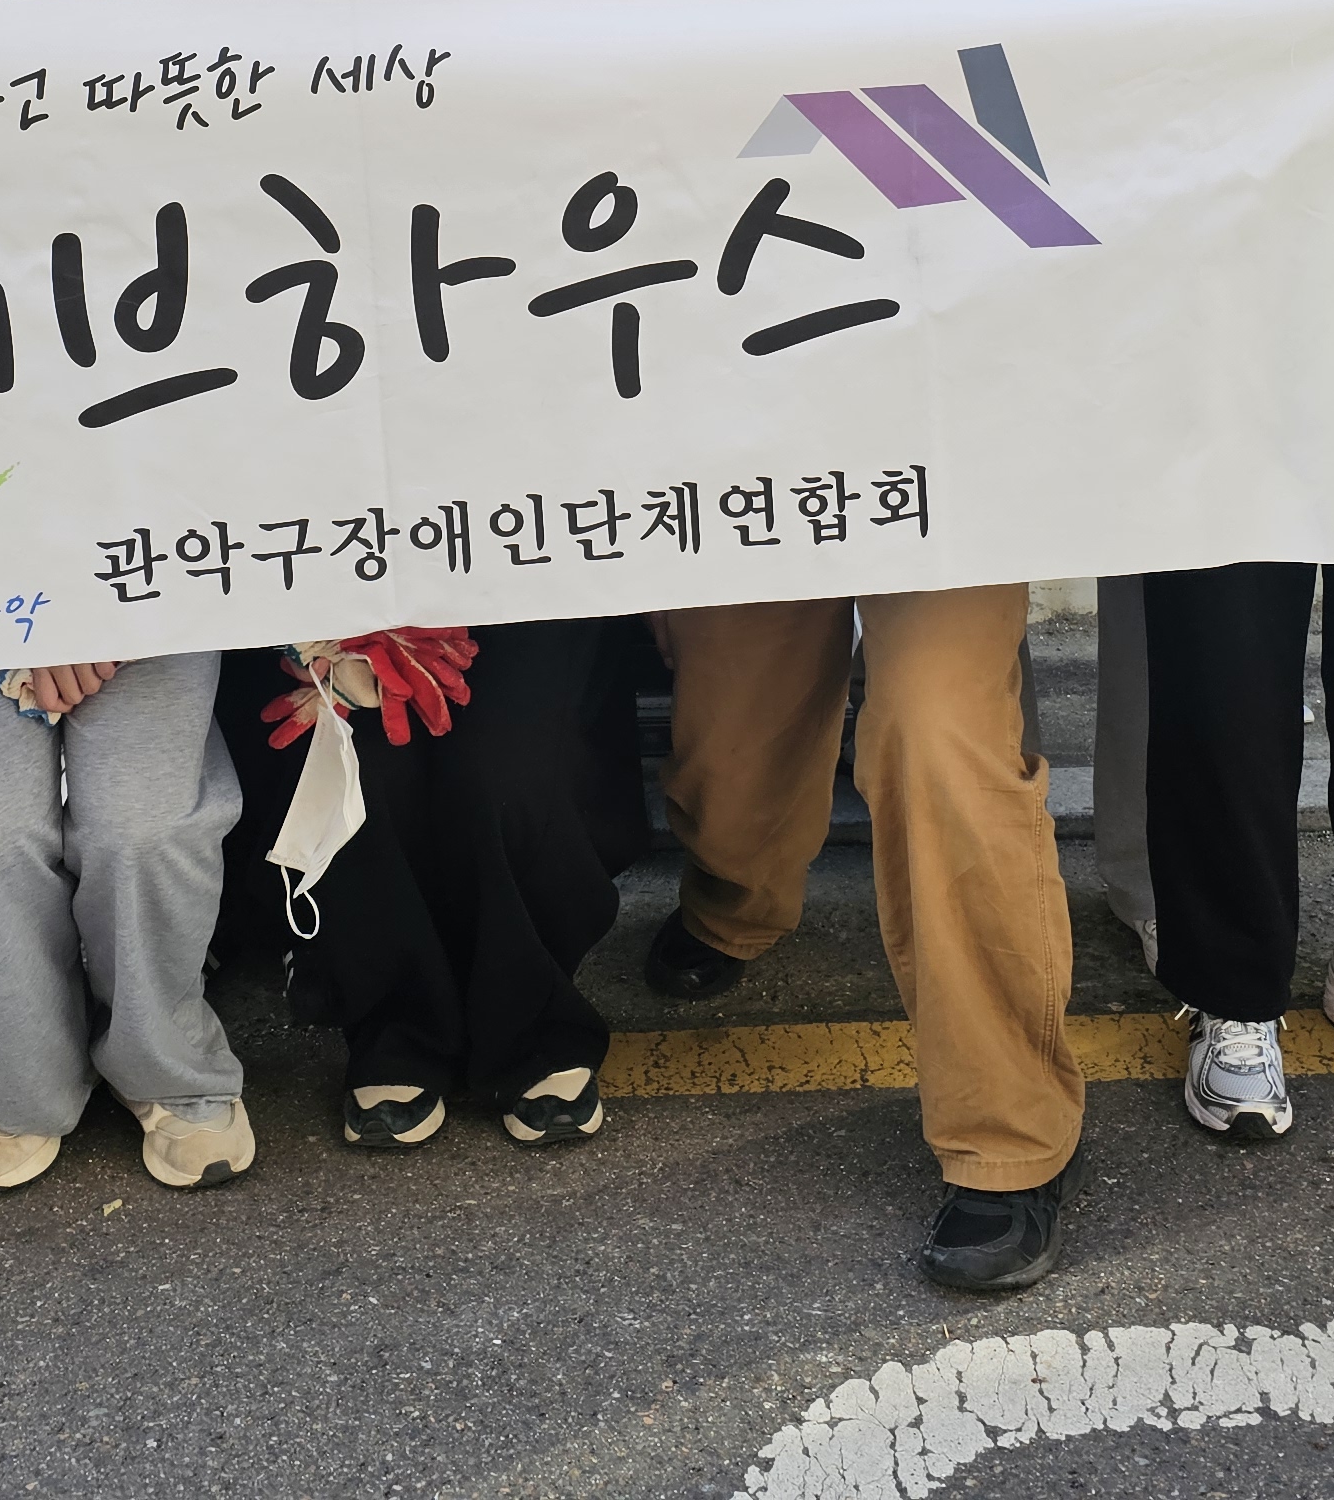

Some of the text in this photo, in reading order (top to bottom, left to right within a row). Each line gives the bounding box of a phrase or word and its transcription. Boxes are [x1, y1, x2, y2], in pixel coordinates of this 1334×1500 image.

[82, 45, 275, 132] 따뜻한
[309, 43, 452, 111] 세상
[93, 464, 930, 603] 관악구장애인단체연합회
